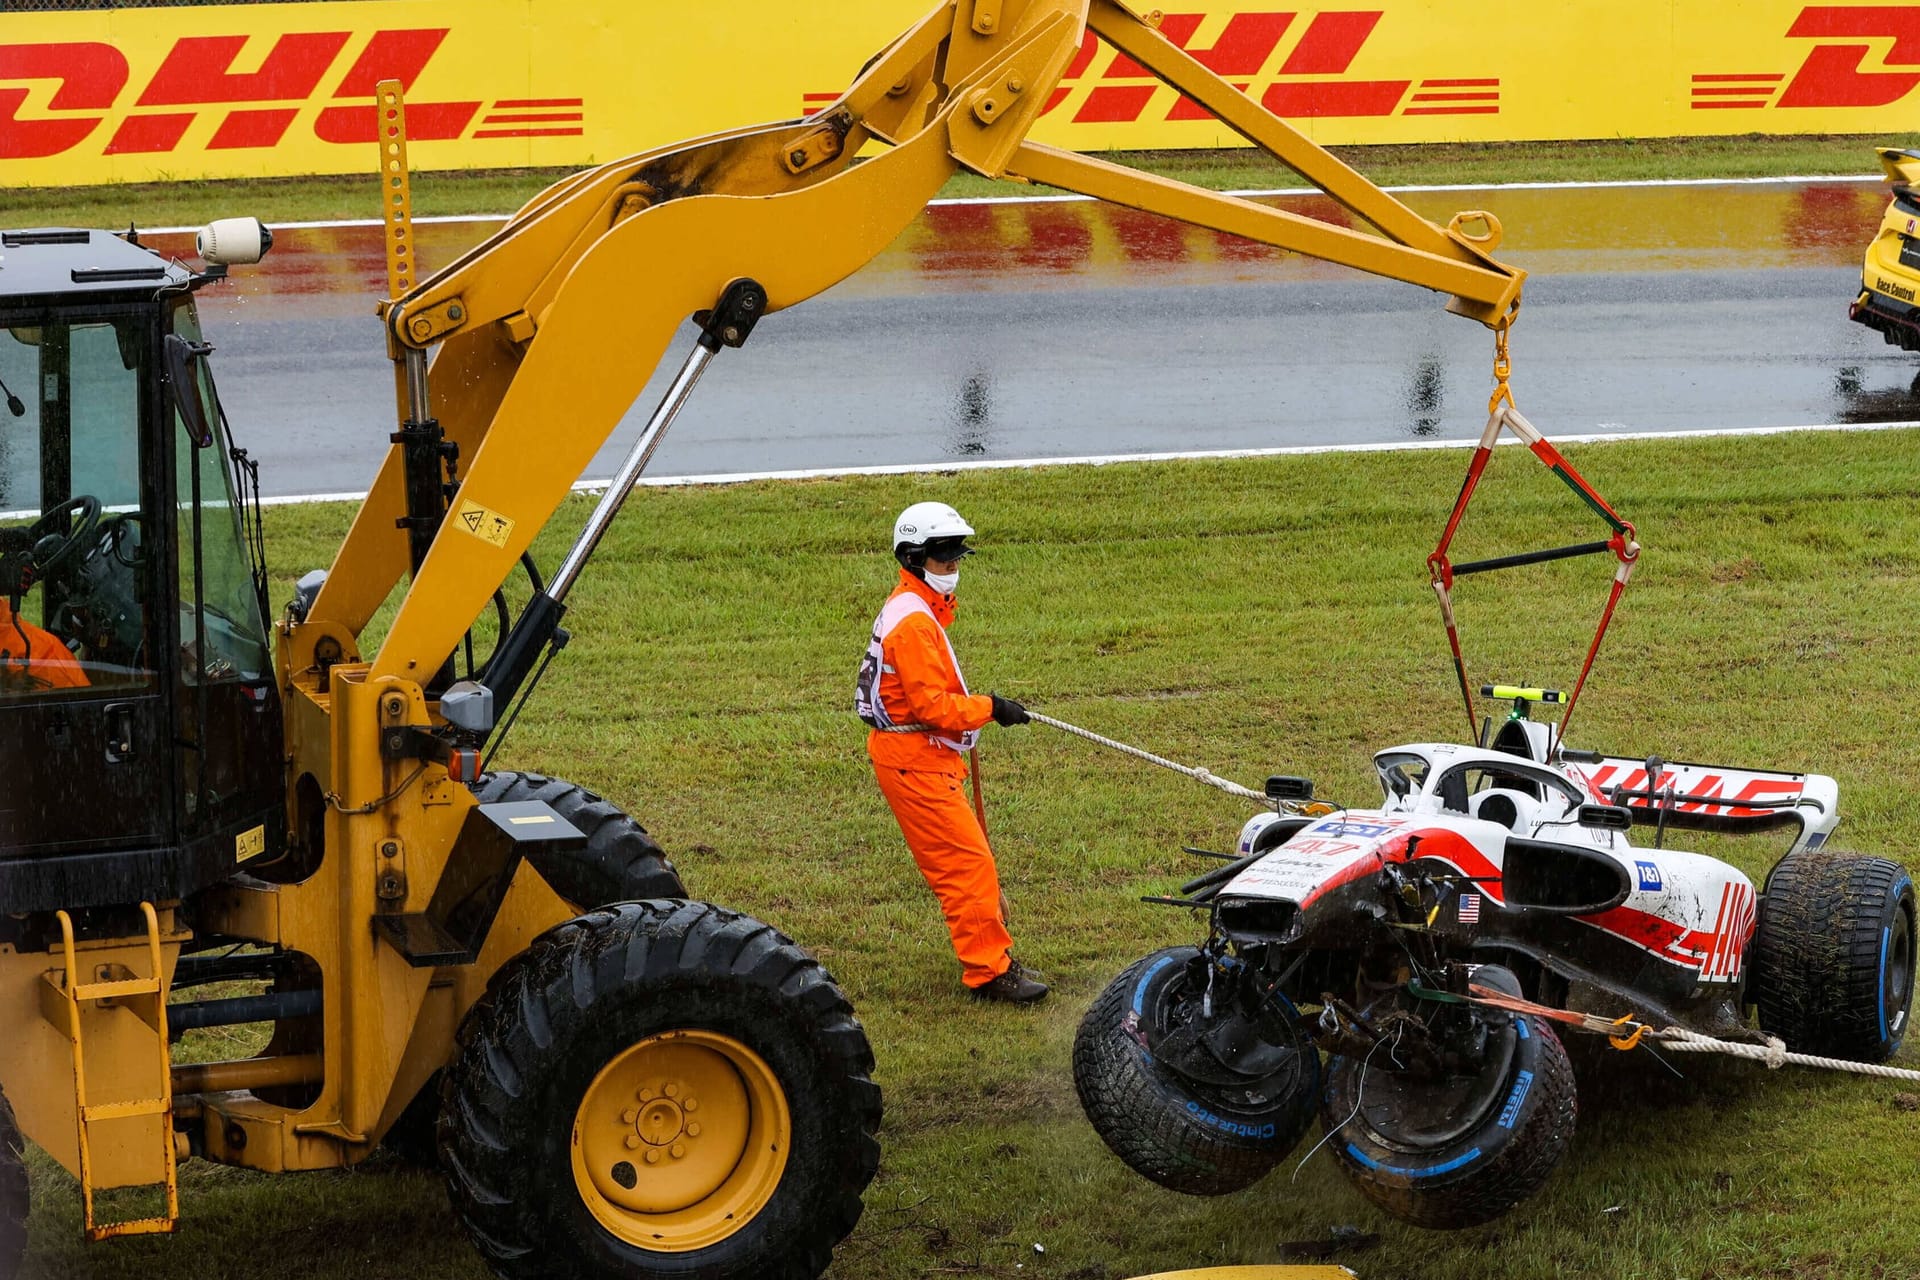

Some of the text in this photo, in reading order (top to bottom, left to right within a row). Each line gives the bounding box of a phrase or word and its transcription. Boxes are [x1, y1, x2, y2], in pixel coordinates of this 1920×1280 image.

[1876, 277, 1916, 302] Race Control
[1638, 865, 1660, 883] 1&1
[1497, 1070, 1534, 1129] PIRELLI
